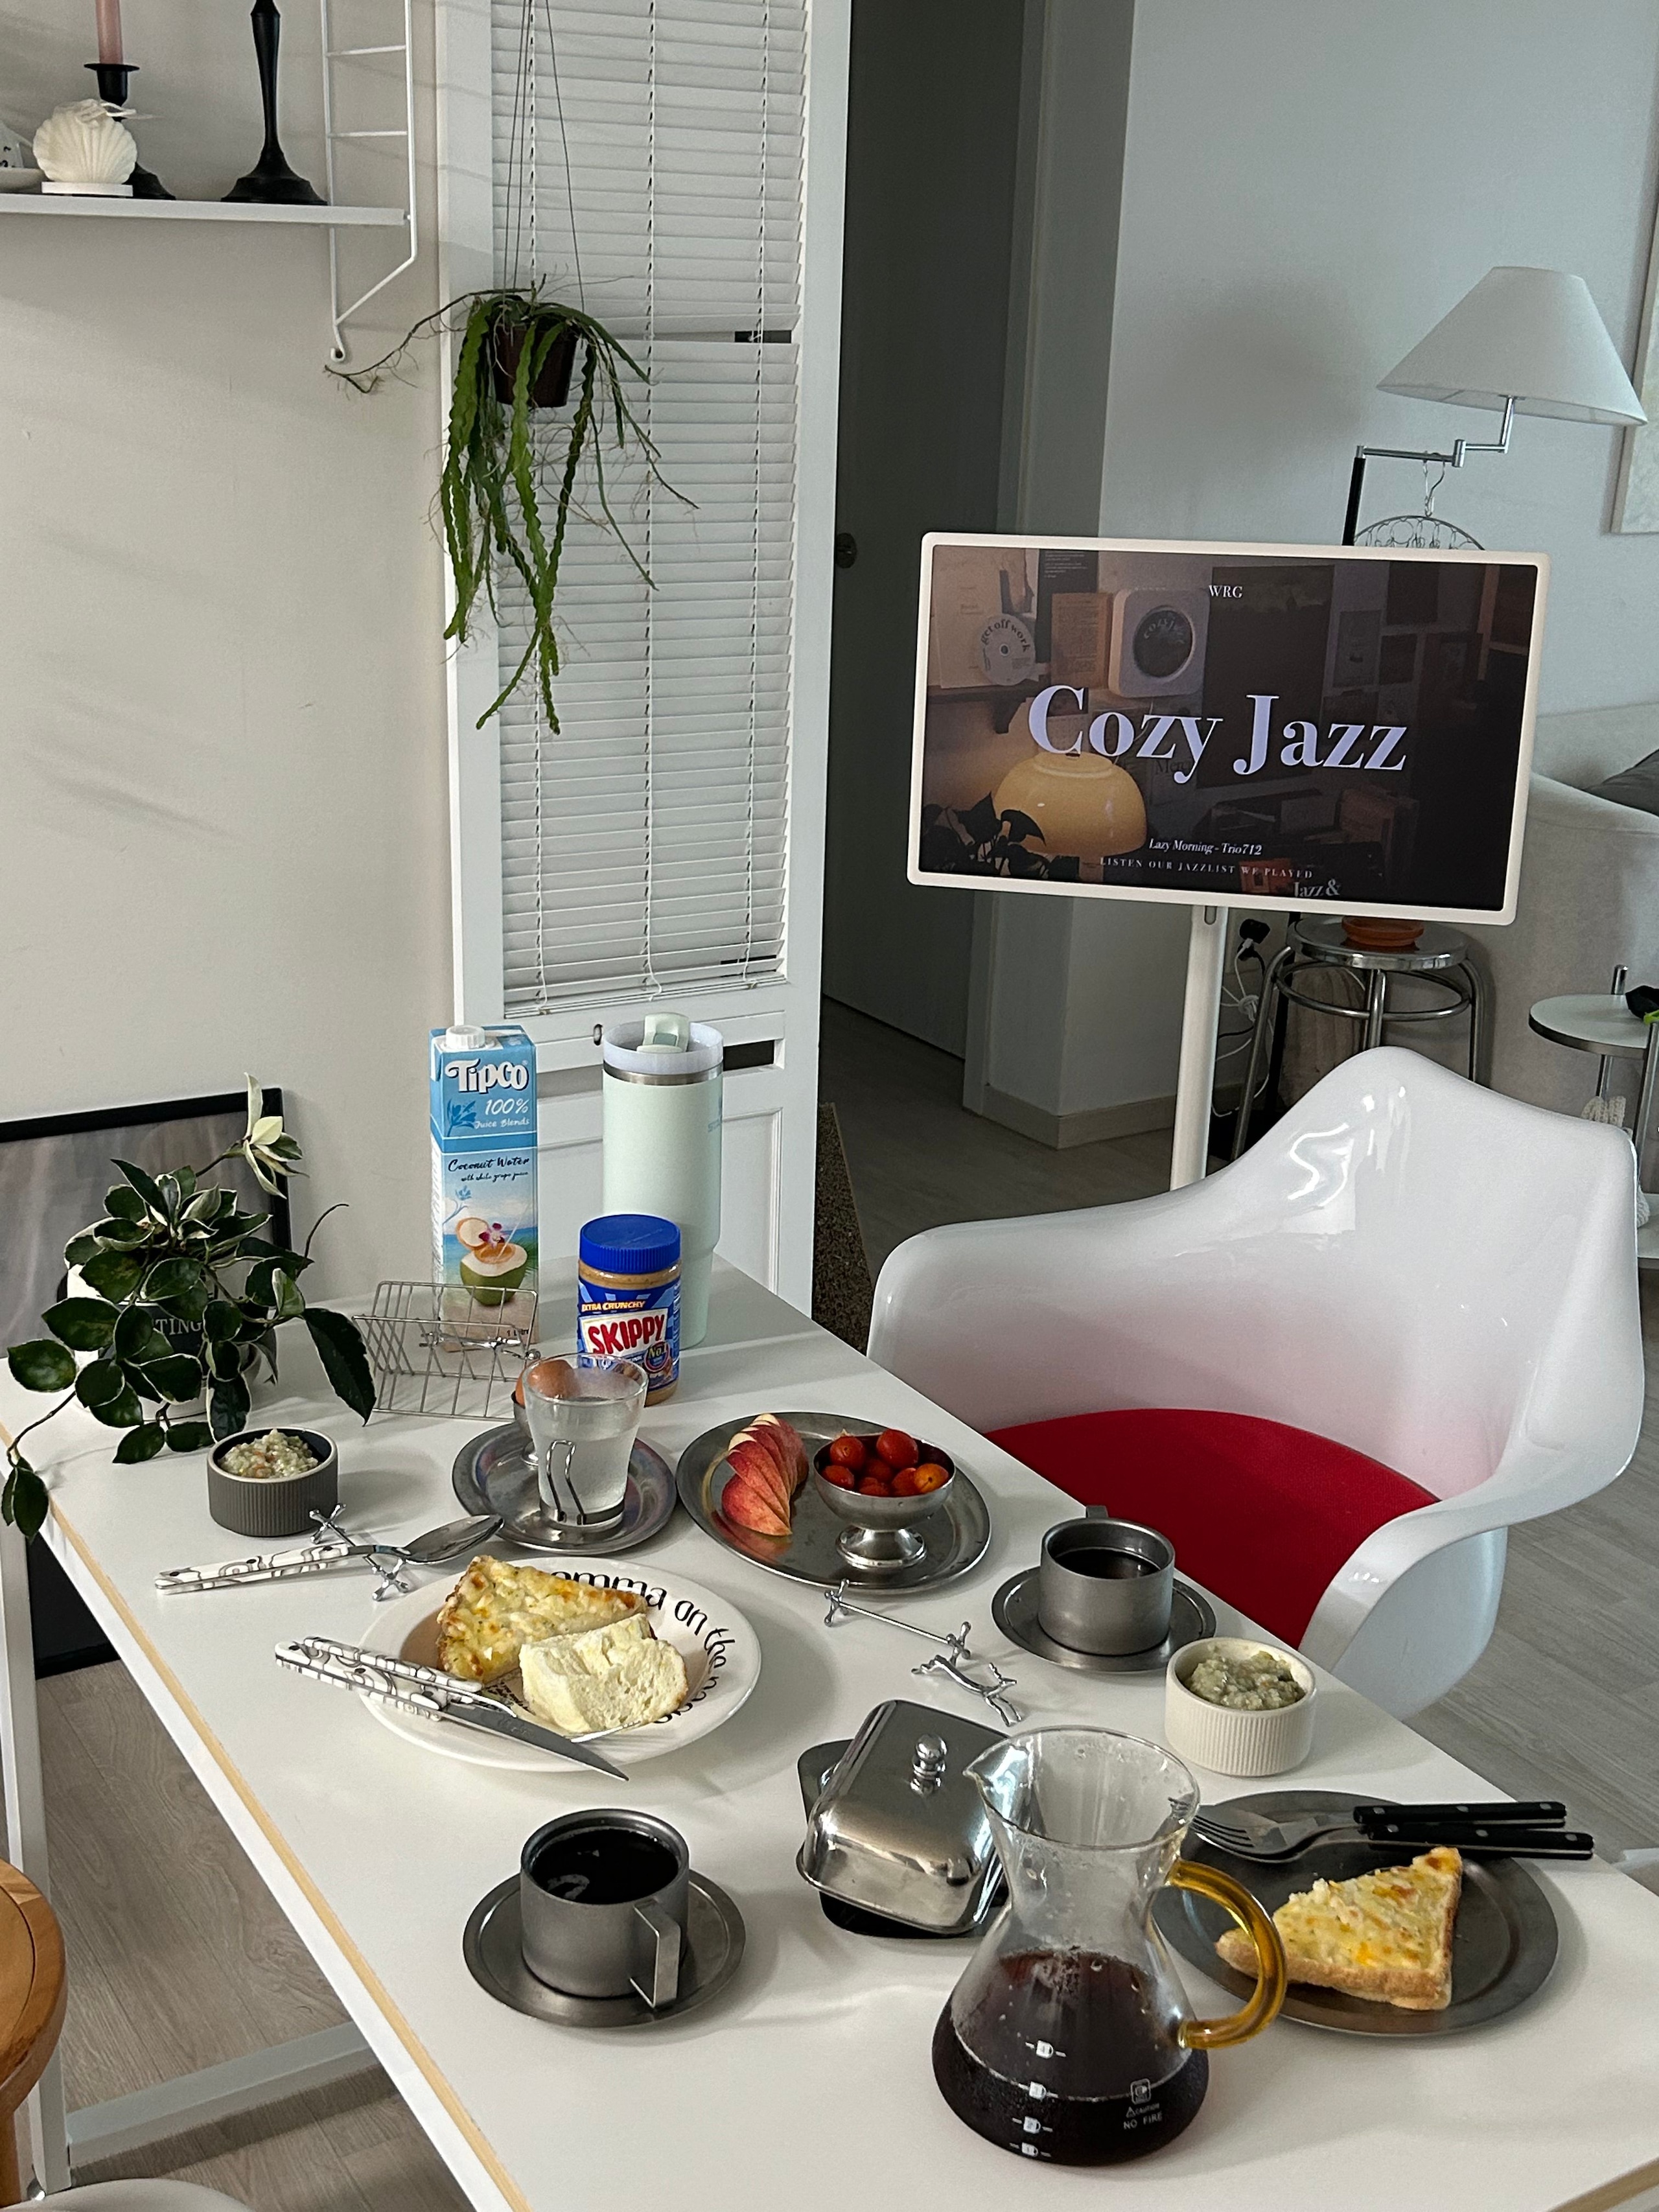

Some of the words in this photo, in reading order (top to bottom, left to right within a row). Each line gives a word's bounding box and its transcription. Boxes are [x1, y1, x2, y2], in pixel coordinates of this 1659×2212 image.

[1209, 585, 1243, 598] WRG
[1028, 684, 1224, 784] Cozy
[1233, 694, 1408, 775] Jazz
[1149, 838, 1170, 853] Lazy
[1172, 840, 1213, 855] Morning
[1100, 857, 1143, 867] LISTEN
[1149, 861, 1172, 870] OUR
[1178, 863, 1235, 874] JAZZLIST
[1241, 866, 1258, 876] WE
[1264, 868, 1313, 879] PLAYED
[1325, 878, 1341, 896] &
[485, 1099, 529, 1115] 100%
[474, 1121, 497, 1130] Juice
[501, 1117, 530, 1128] Blends
[448, 1159, 496, 1172] Coconut
[498, 1156, 529, 1167] Water
[602, 1300, 645, 1310] CRUNCHY
[588, 1314, 665, 1355] SKIPPY
[675, 1600, 708, 1636] on
[704, 1628, 736, 1673] the
[1124, 2119, 1137, 2130] NO
[1143, 2111, 1163, 2125] FIRE
